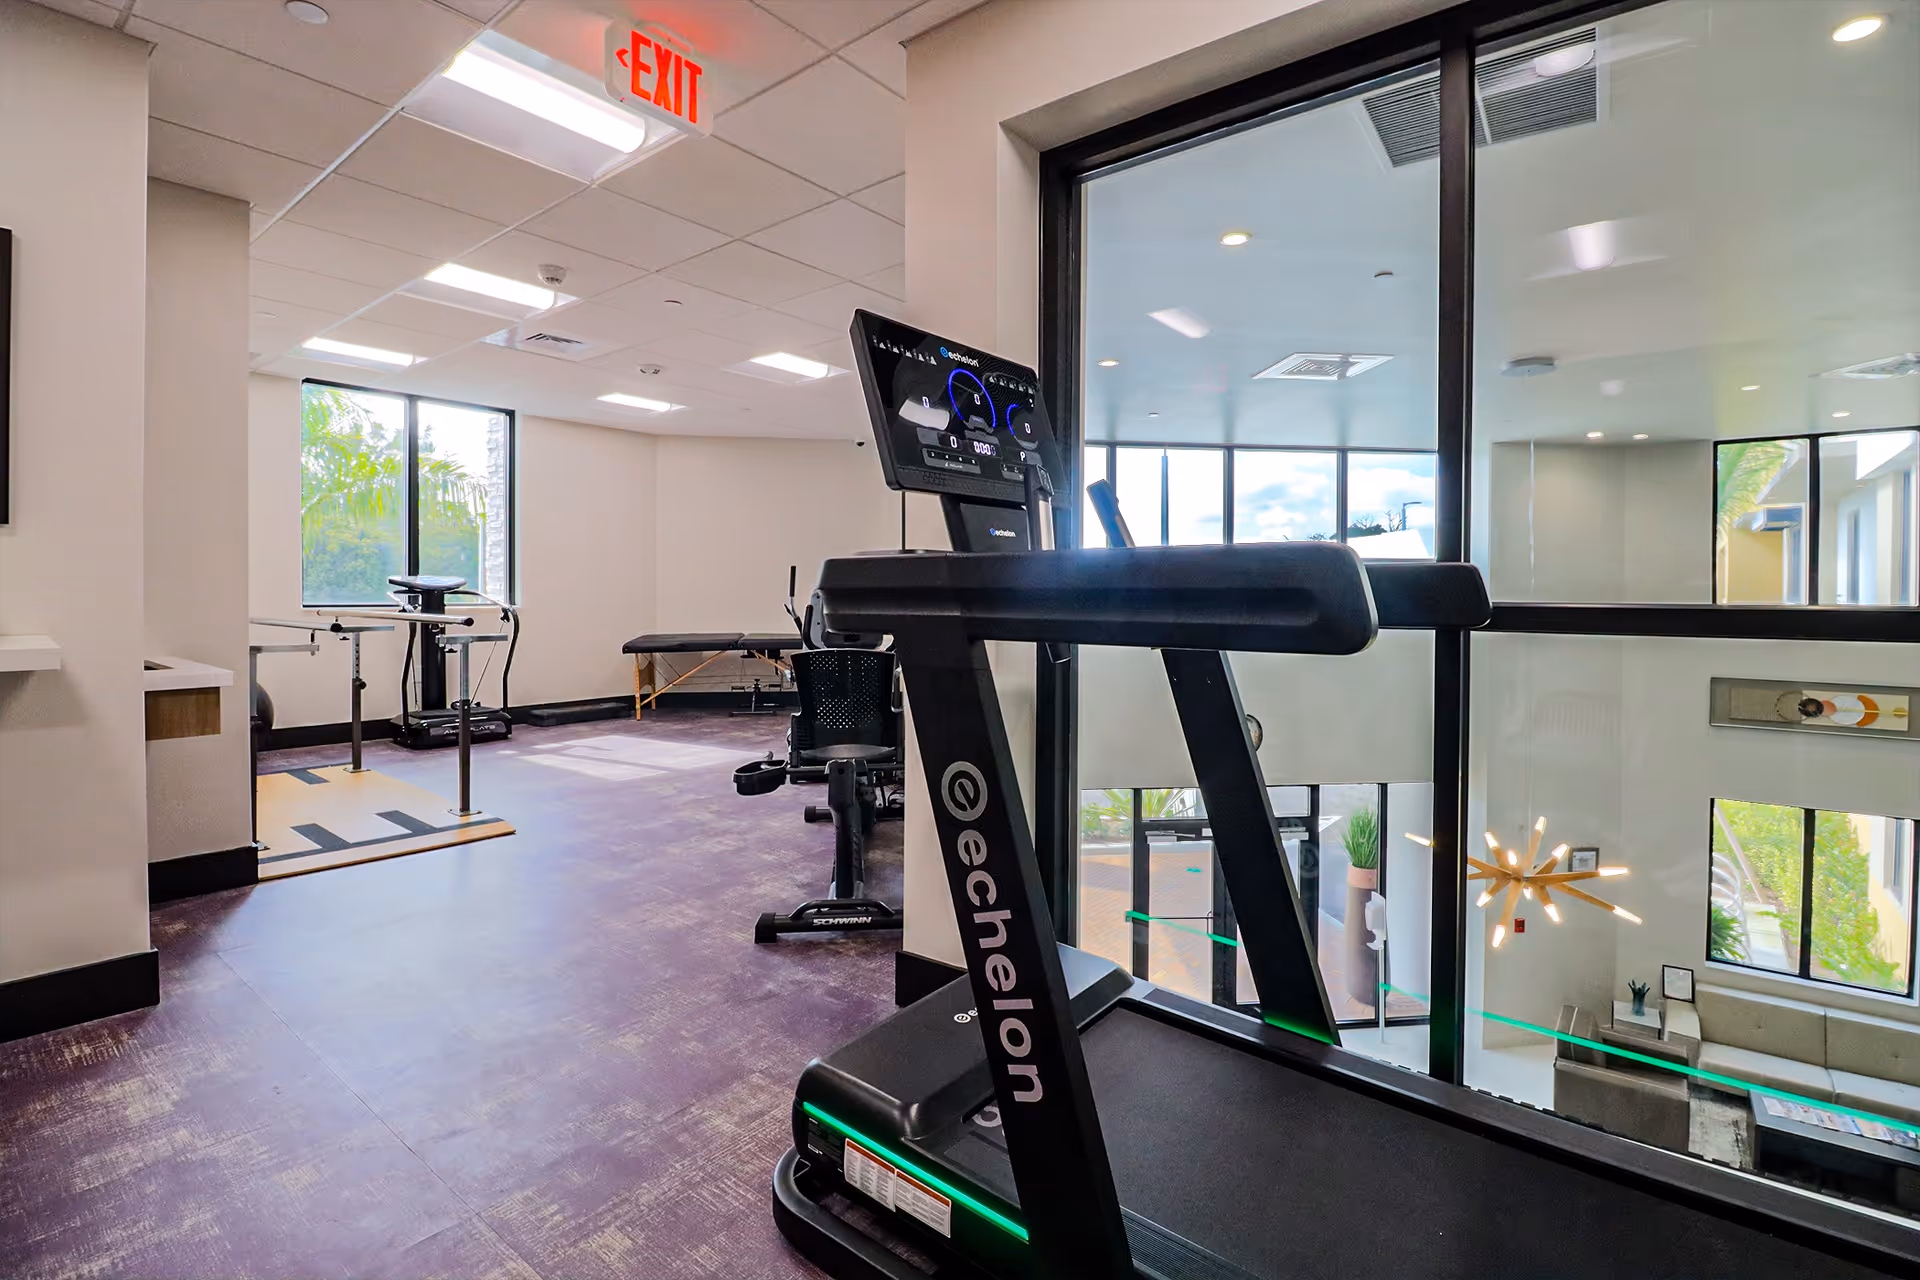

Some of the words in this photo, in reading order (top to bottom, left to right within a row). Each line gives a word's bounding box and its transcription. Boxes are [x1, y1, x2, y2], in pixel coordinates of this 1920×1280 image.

[631, 30, 703, 124] EXIT
[948, 351, 980, 368] echelon
[812, 916, 873, 926] SCHWINN
[957, 829, 1043, 1103] echelon
